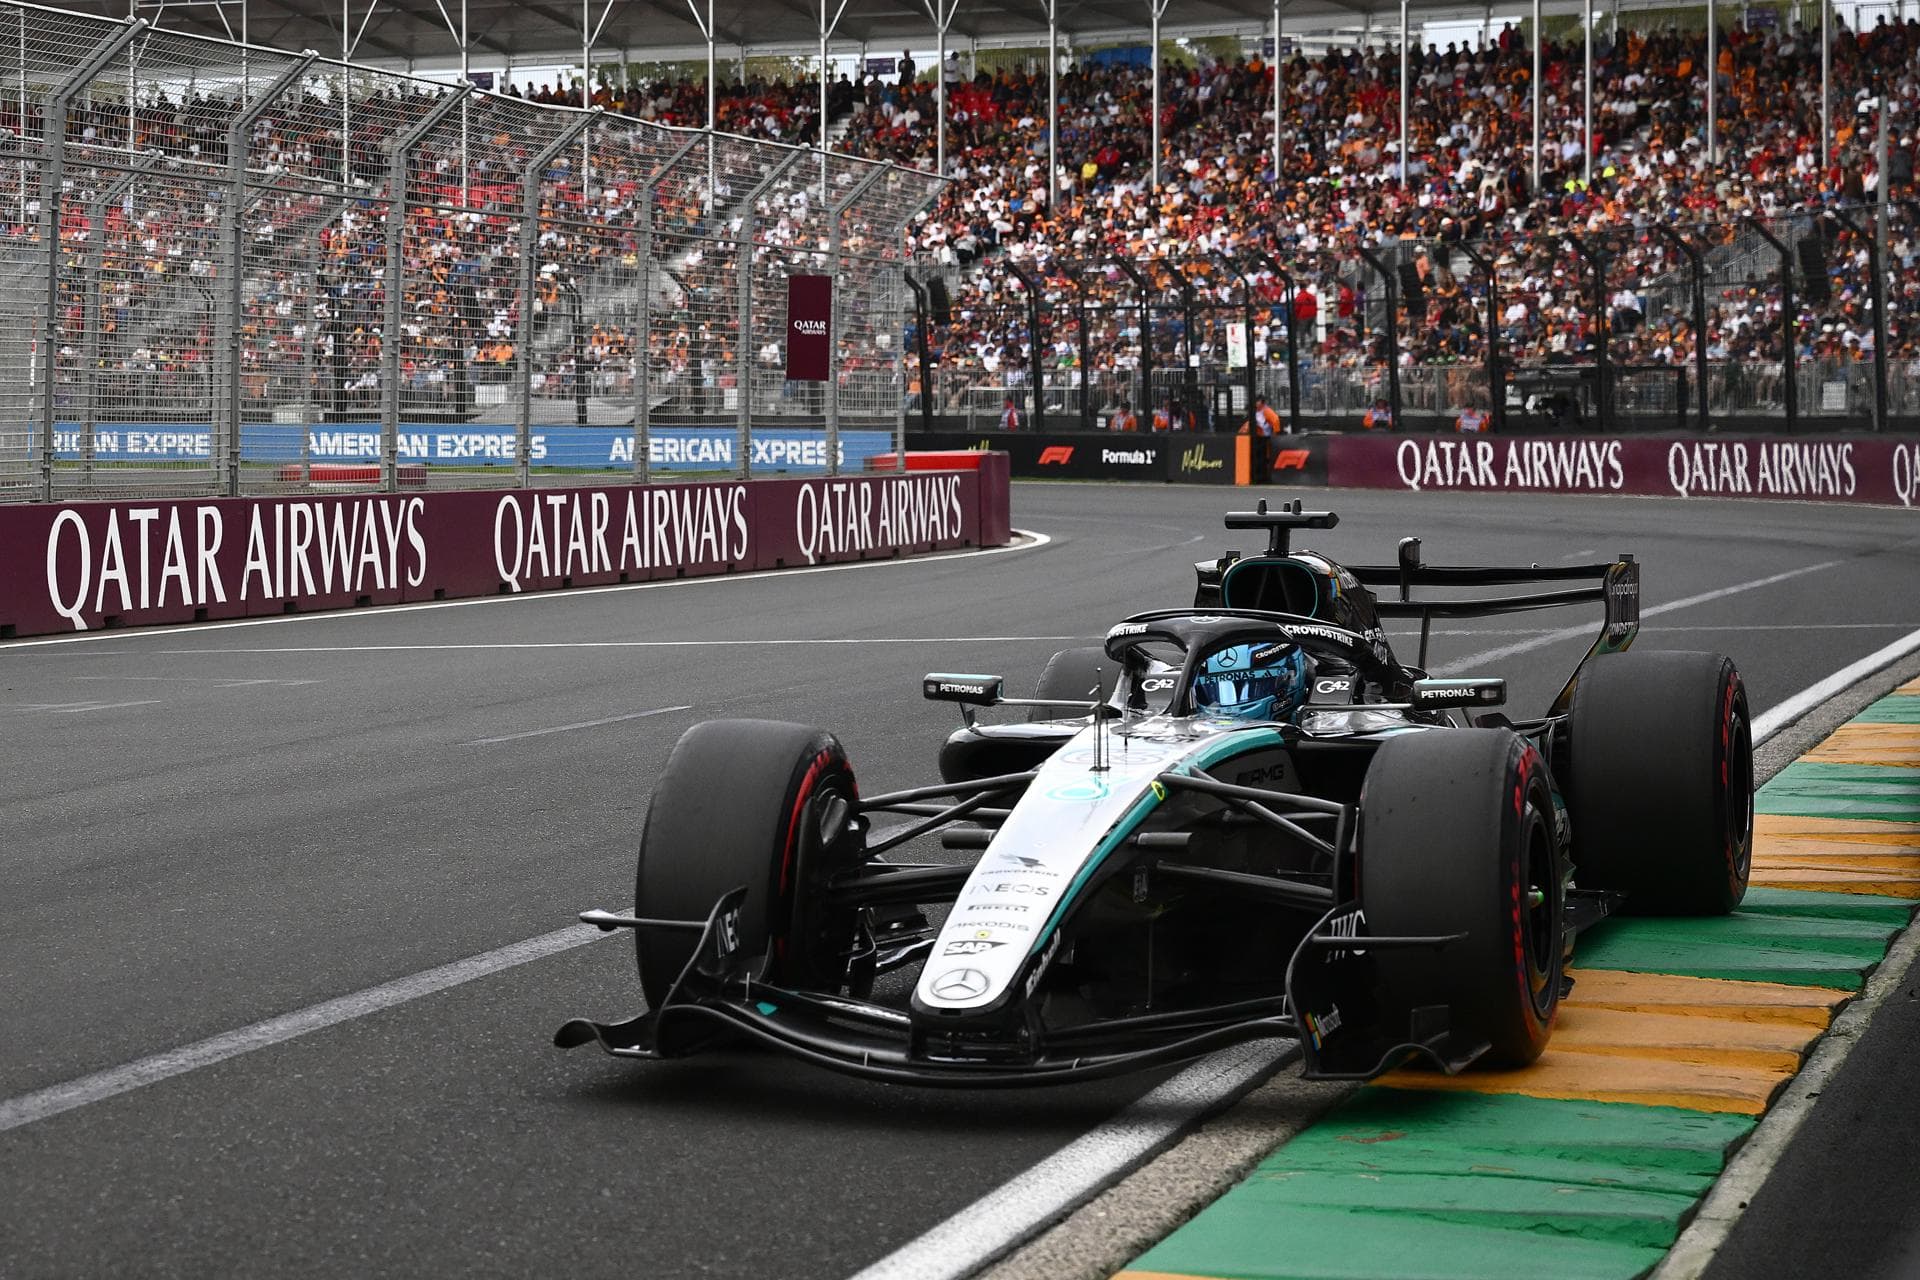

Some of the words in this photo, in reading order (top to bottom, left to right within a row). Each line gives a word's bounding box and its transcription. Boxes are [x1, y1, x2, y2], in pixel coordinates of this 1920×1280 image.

[793, 319, 826, 331] QATAR
[127, 431, 211, 455] EXPRE
[300, 432, 428, 457] AMERIAN
[437, 434, 547, 459] EXPRES
[1102, 448, 1146, 465] Formula
[1396, 440, 1498, 493] QATAR
[1504, 440, 1624, 489] AIRWAYS
[1668, 442, 1753, 498] QATAR
[1757, 443, 1856, 496] AIRWAYS
[796, 482, 874, 564] QATAR
[877, 475, 962, 547] AIRWAYS
[494, 490, 611, 592] QATAR
[619, 486, 748, 570] AIRWAYS
[47, 505, 227, 630] QATAR
[240, 497, 427, 601] AIRWAYS
[1284, 624, 1354, 648] CROWDSTRIKE
[1141, 678, 1175, 692] G42
[1204, 671, 1256, 684] PETRONAS
[940, 683, 984, 695] PETRONAS
[1316, 680, 1350, 694] G42
[1420, 688, 1476, 699] PETRONAS
[969, 882, 1050, 897] INEOS
[944, 941, 995, 957] SAP
